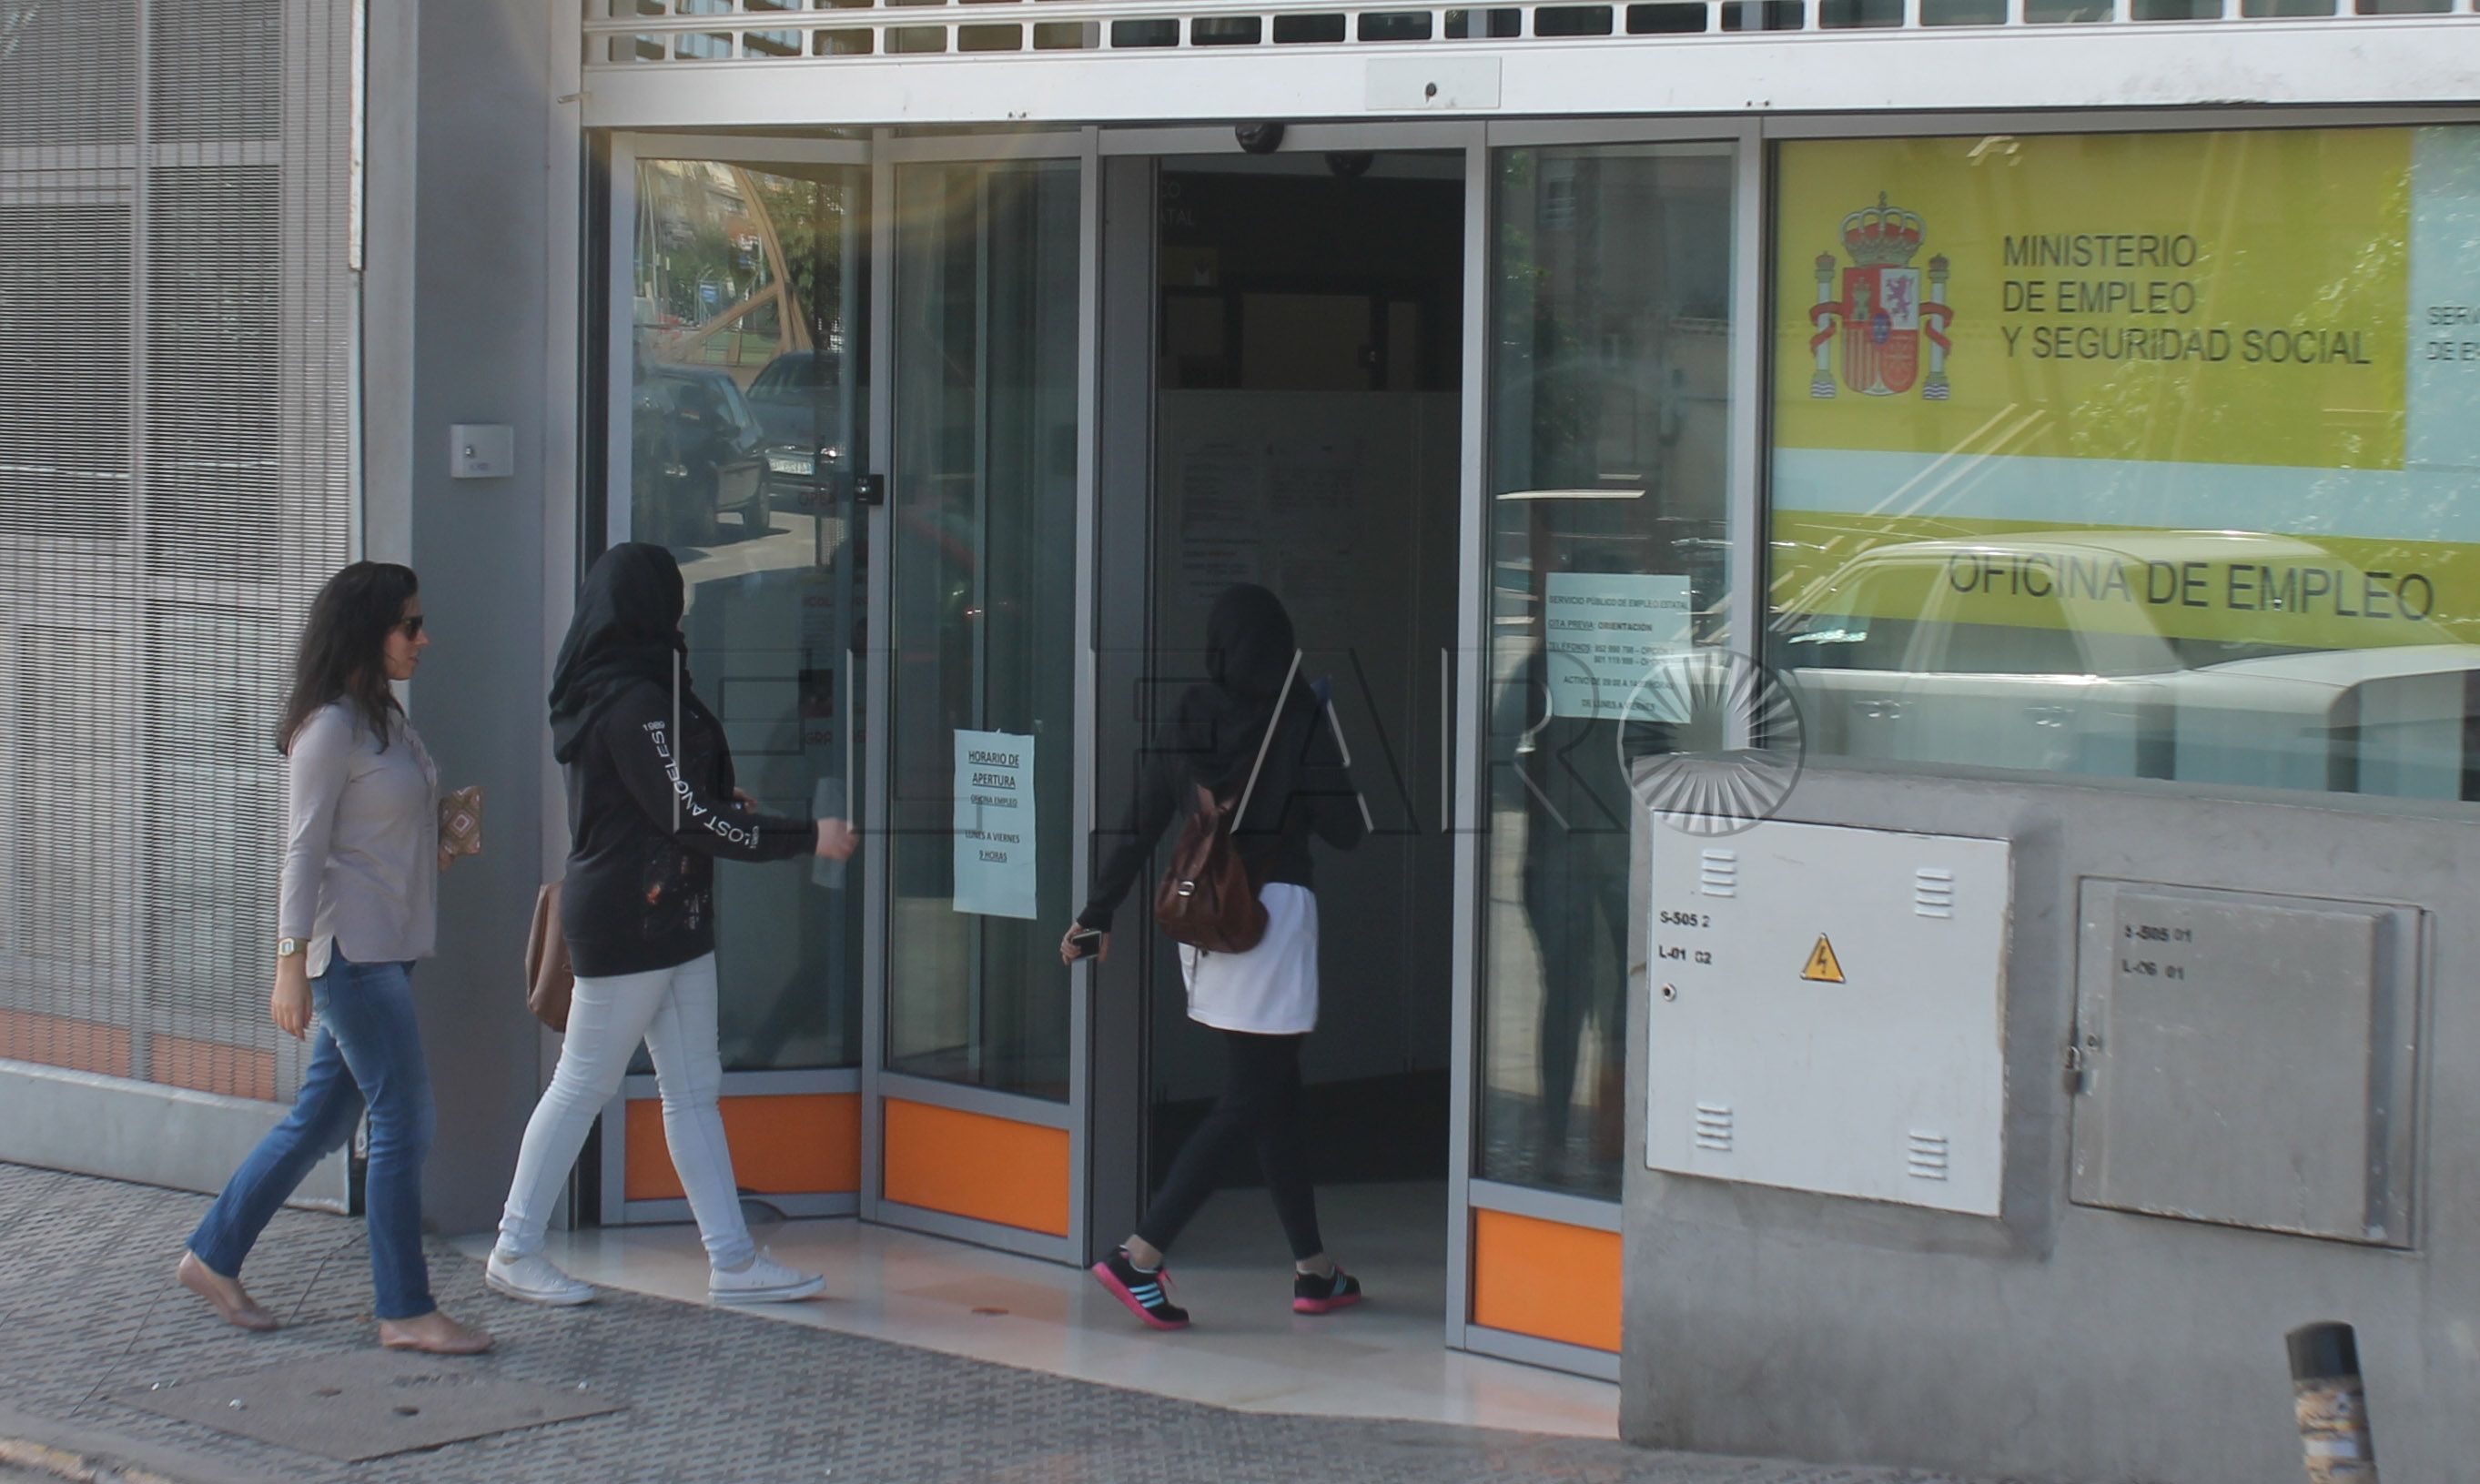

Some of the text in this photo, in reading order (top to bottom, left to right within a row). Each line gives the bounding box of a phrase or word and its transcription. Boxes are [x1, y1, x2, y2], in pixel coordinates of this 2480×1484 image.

[2004, 234, 2197, 268] MINISTERIO
[2003, 280, 2196, 314] DE EMPLEO
[2001, 326, 2373, 365] Y SEGURIDAD SOCIAL
[2426, 340, 2455, 361] DE
[1947, 549, 2435, 621] OFICINA DE EMPLEO
[1548, 595, 1584, 605] SERVICIO
[1628, 599, 1659, 609] EMPLEO
[968, 750, 1019, 767] HORARIO DE
[972, 772, 1017, 789] APERTURA
[993, 797, 1018, 808] EMPLEO
[965, 829, 1020, 843] LUNES A VIERNES
[985, 851, 1007, 863] HORAS
[1660, 911, 1698, 927] S-505
[1658, 944, 1686, 962] L-01
